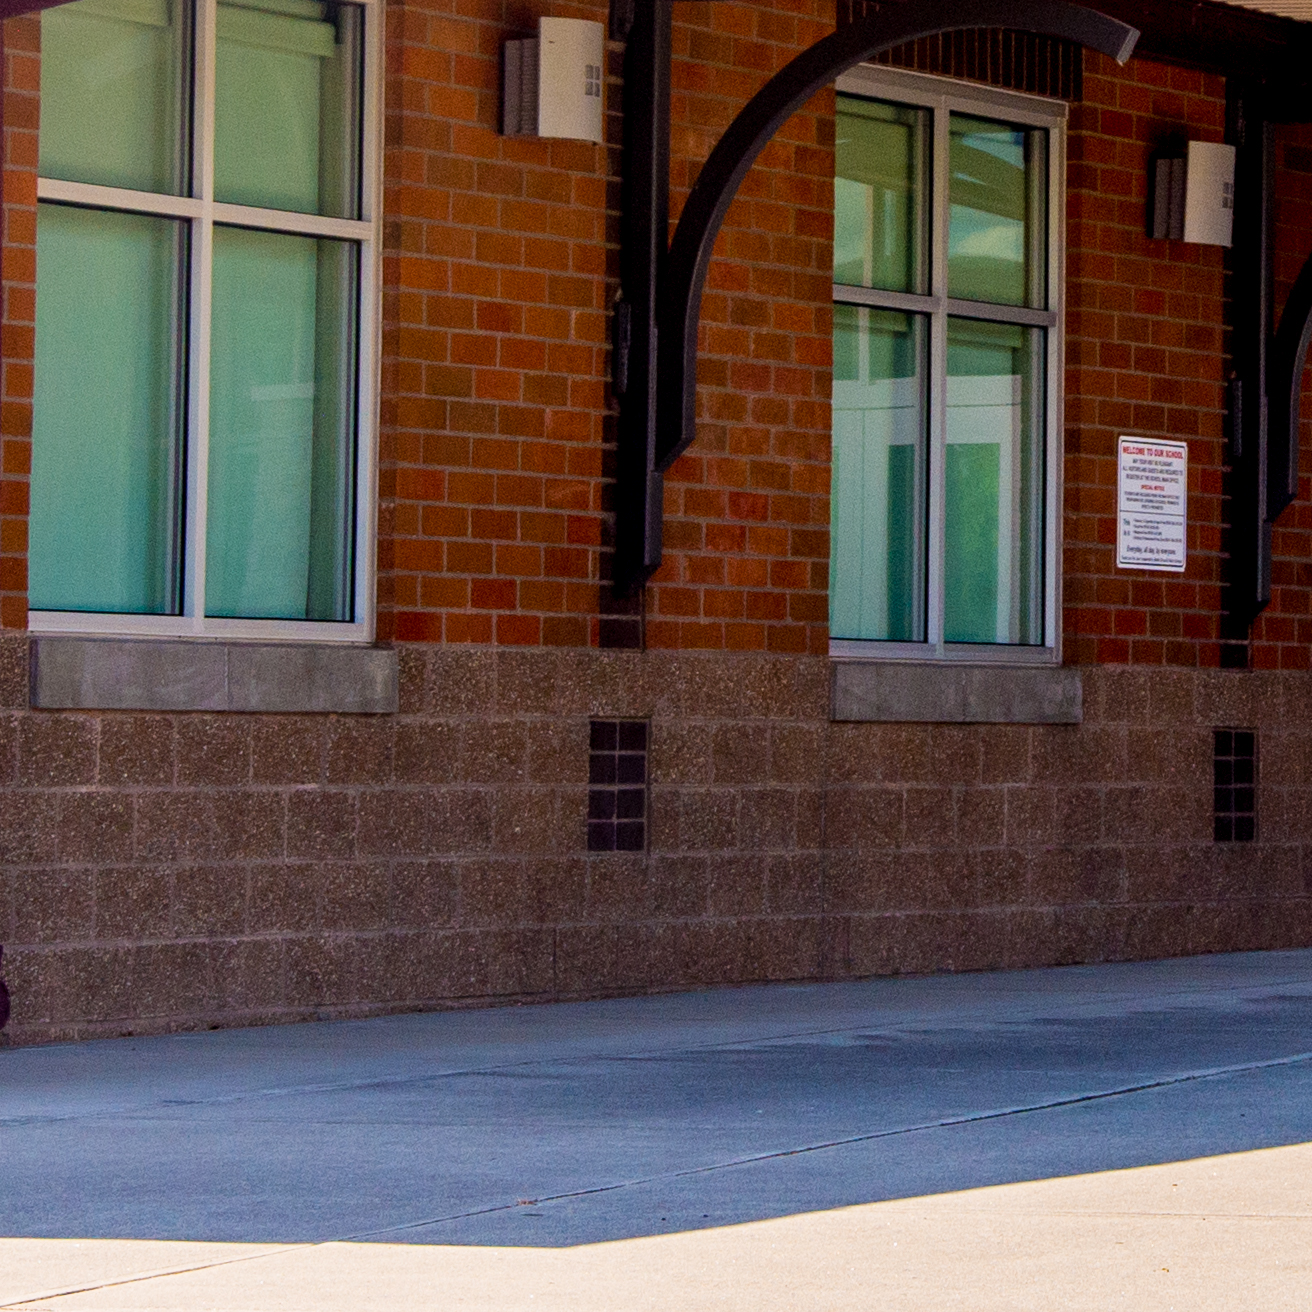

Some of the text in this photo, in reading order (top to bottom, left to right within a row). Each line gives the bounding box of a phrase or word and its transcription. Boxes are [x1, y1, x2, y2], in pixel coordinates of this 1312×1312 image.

[1122, 446, 1184, 460] WELCOME TO OUR SCHOOL
